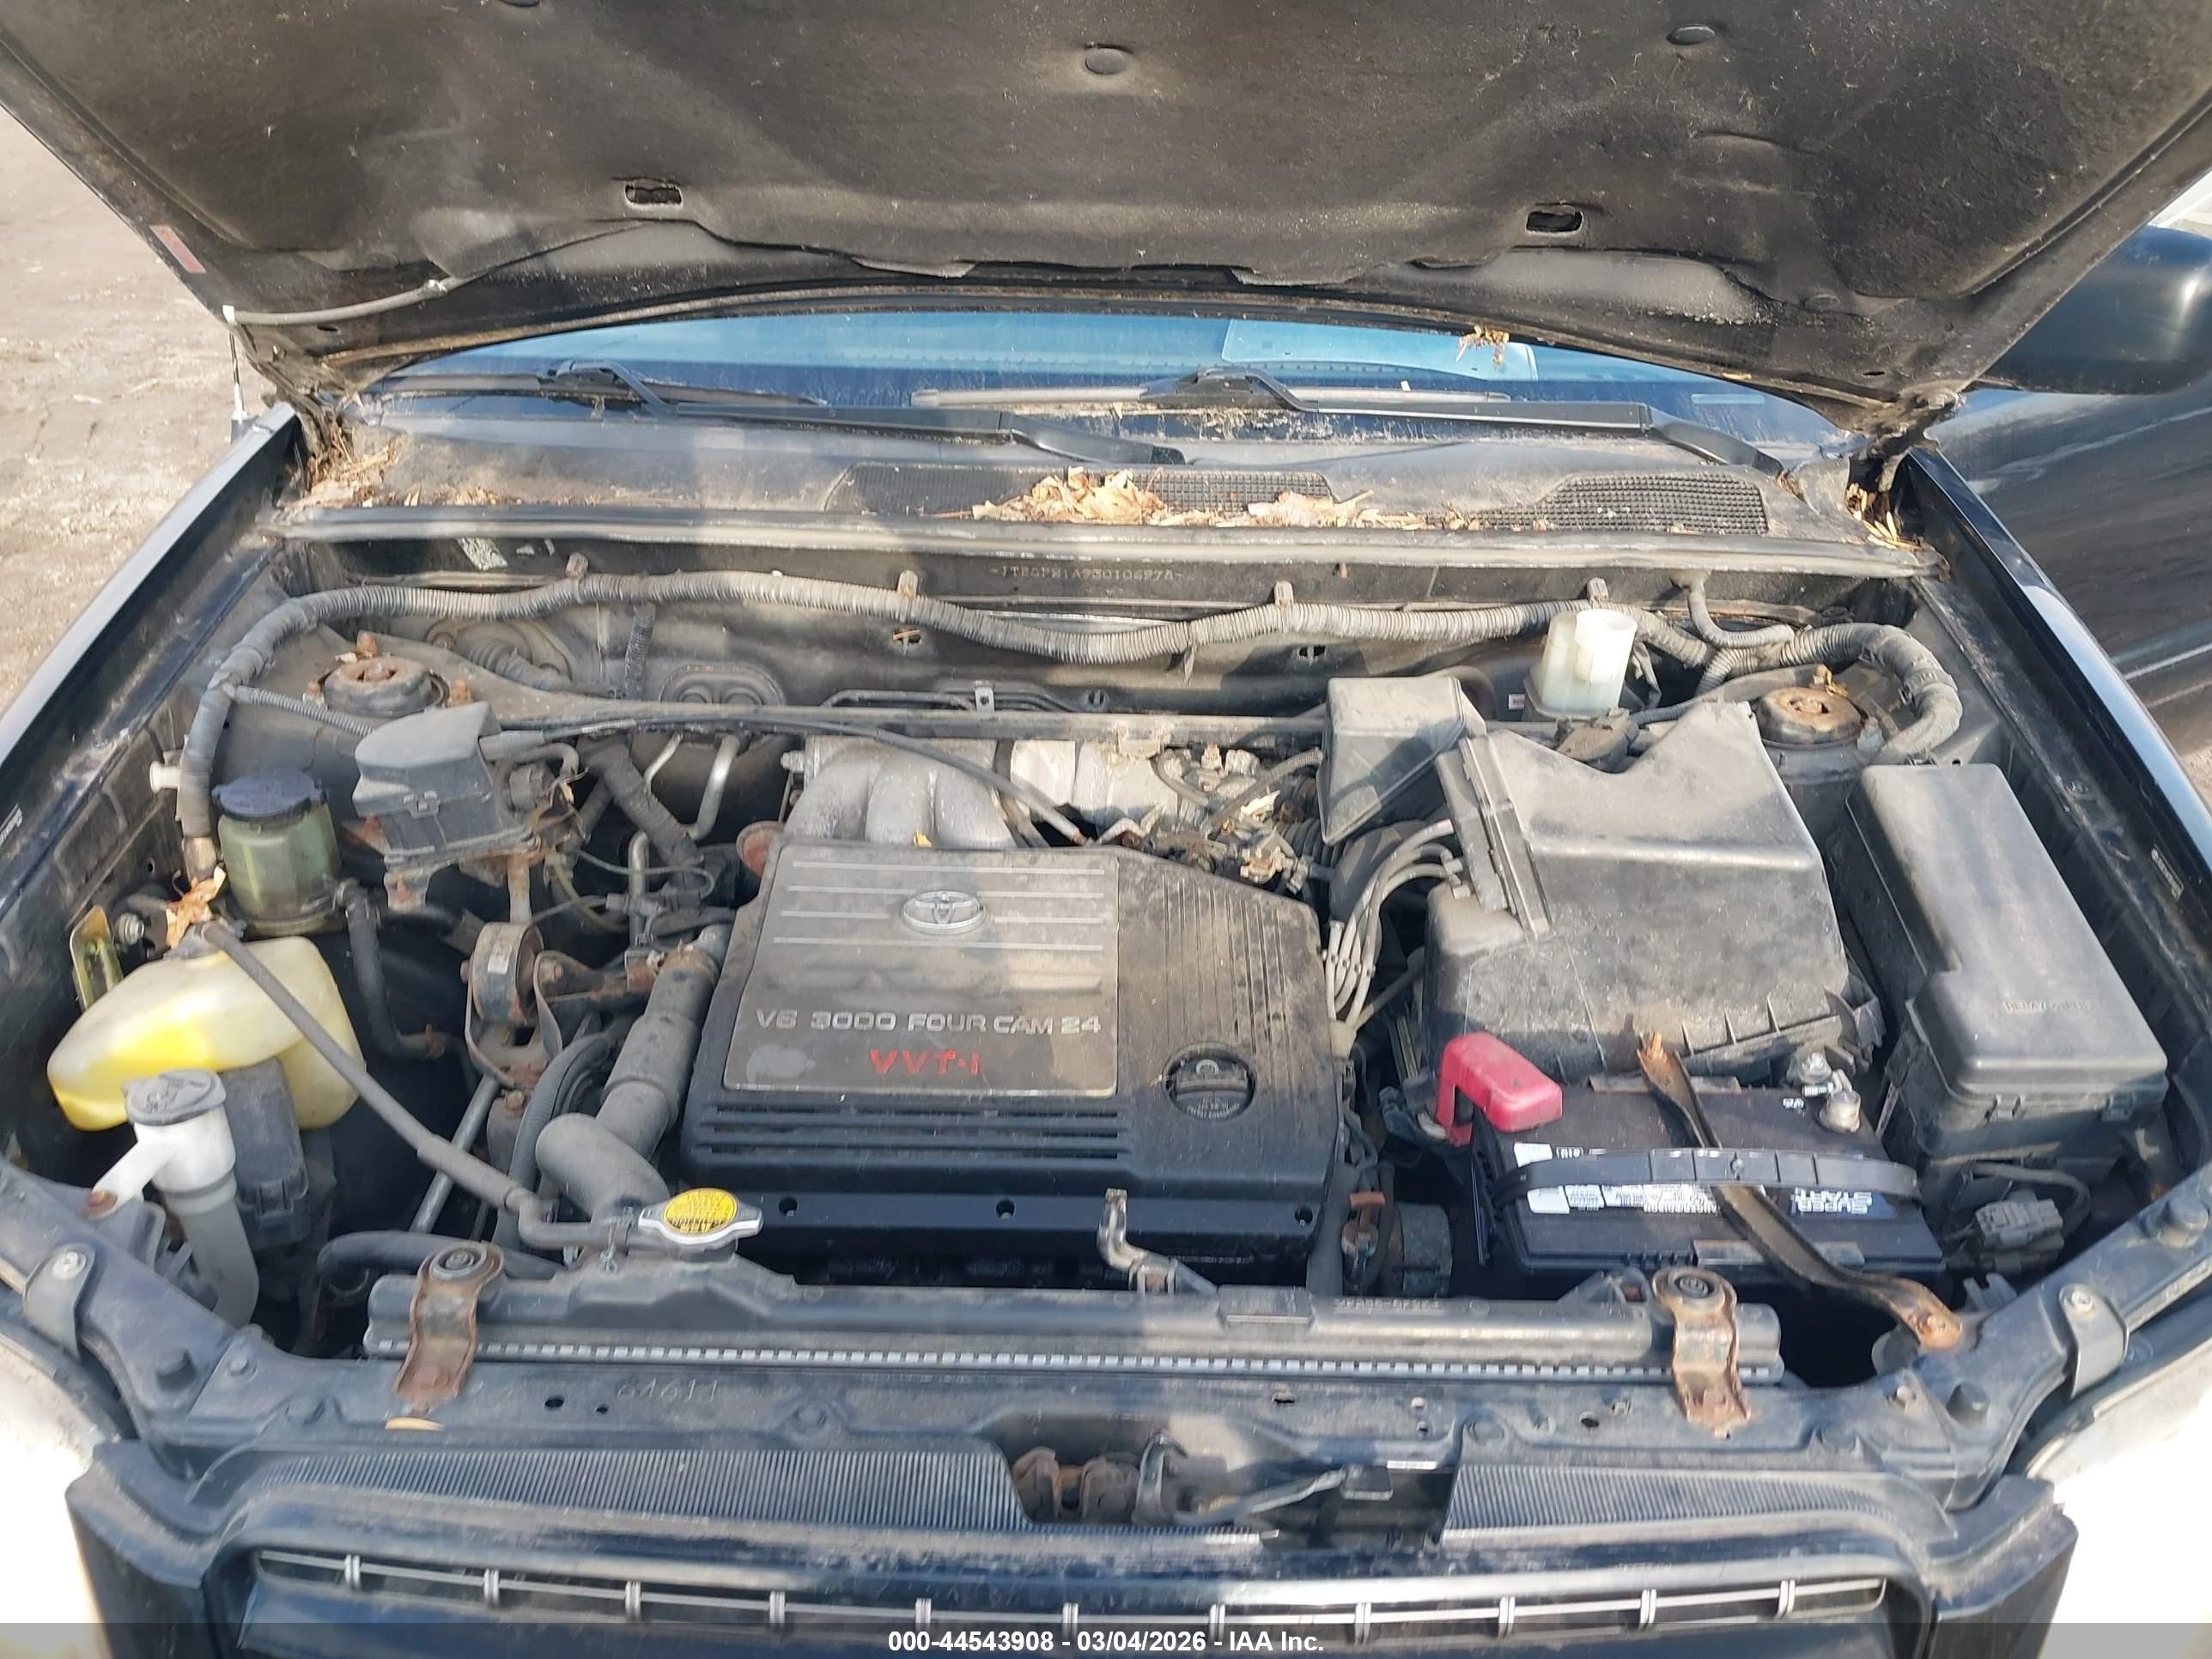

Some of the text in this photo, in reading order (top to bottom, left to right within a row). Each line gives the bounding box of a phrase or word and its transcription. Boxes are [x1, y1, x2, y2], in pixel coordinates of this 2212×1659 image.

[757, 1008, 1102, 1035] V6 3000 FOUR CAM 24
